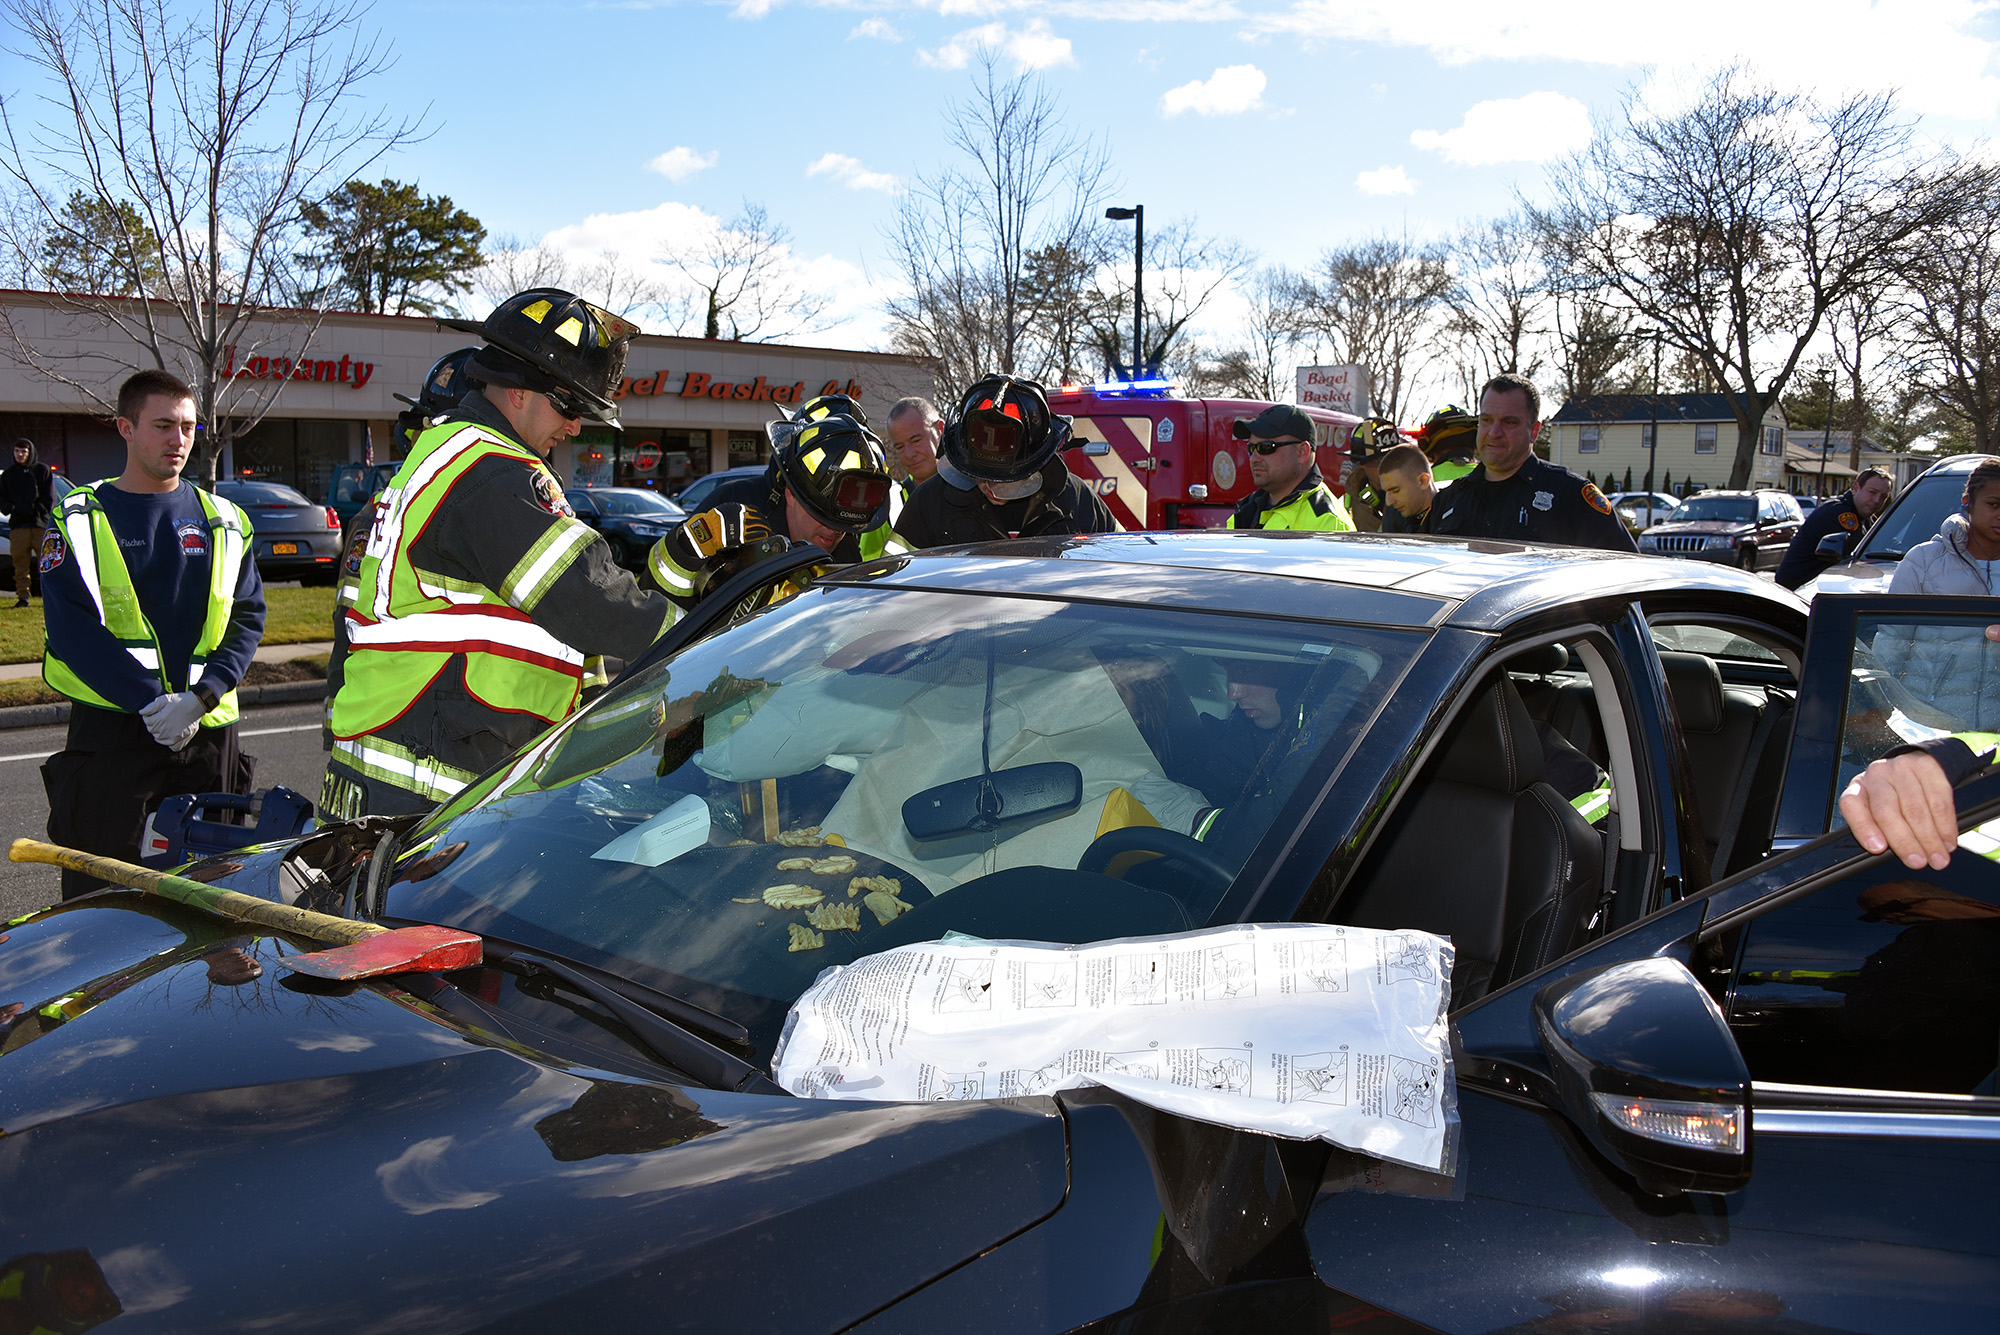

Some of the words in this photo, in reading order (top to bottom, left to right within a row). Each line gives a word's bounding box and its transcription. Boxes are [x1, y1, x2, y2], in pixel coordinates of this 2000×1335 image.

[223, 344, 374, 389] Lavanty
[613, 371, 669, 400] gel
[681, 372, 805, 402] Basket
[1308, 371, 1348, 387] Bagel
[1303, 390, 1351, 403] Basket
[731, 441, 755, 452] OPEN
[983, 426, 999, 451] 1
[1376, 432, 1398, 447] 144
[851, 481, 869, 509] 1
[840, 511, 869, 520] COMMACK
